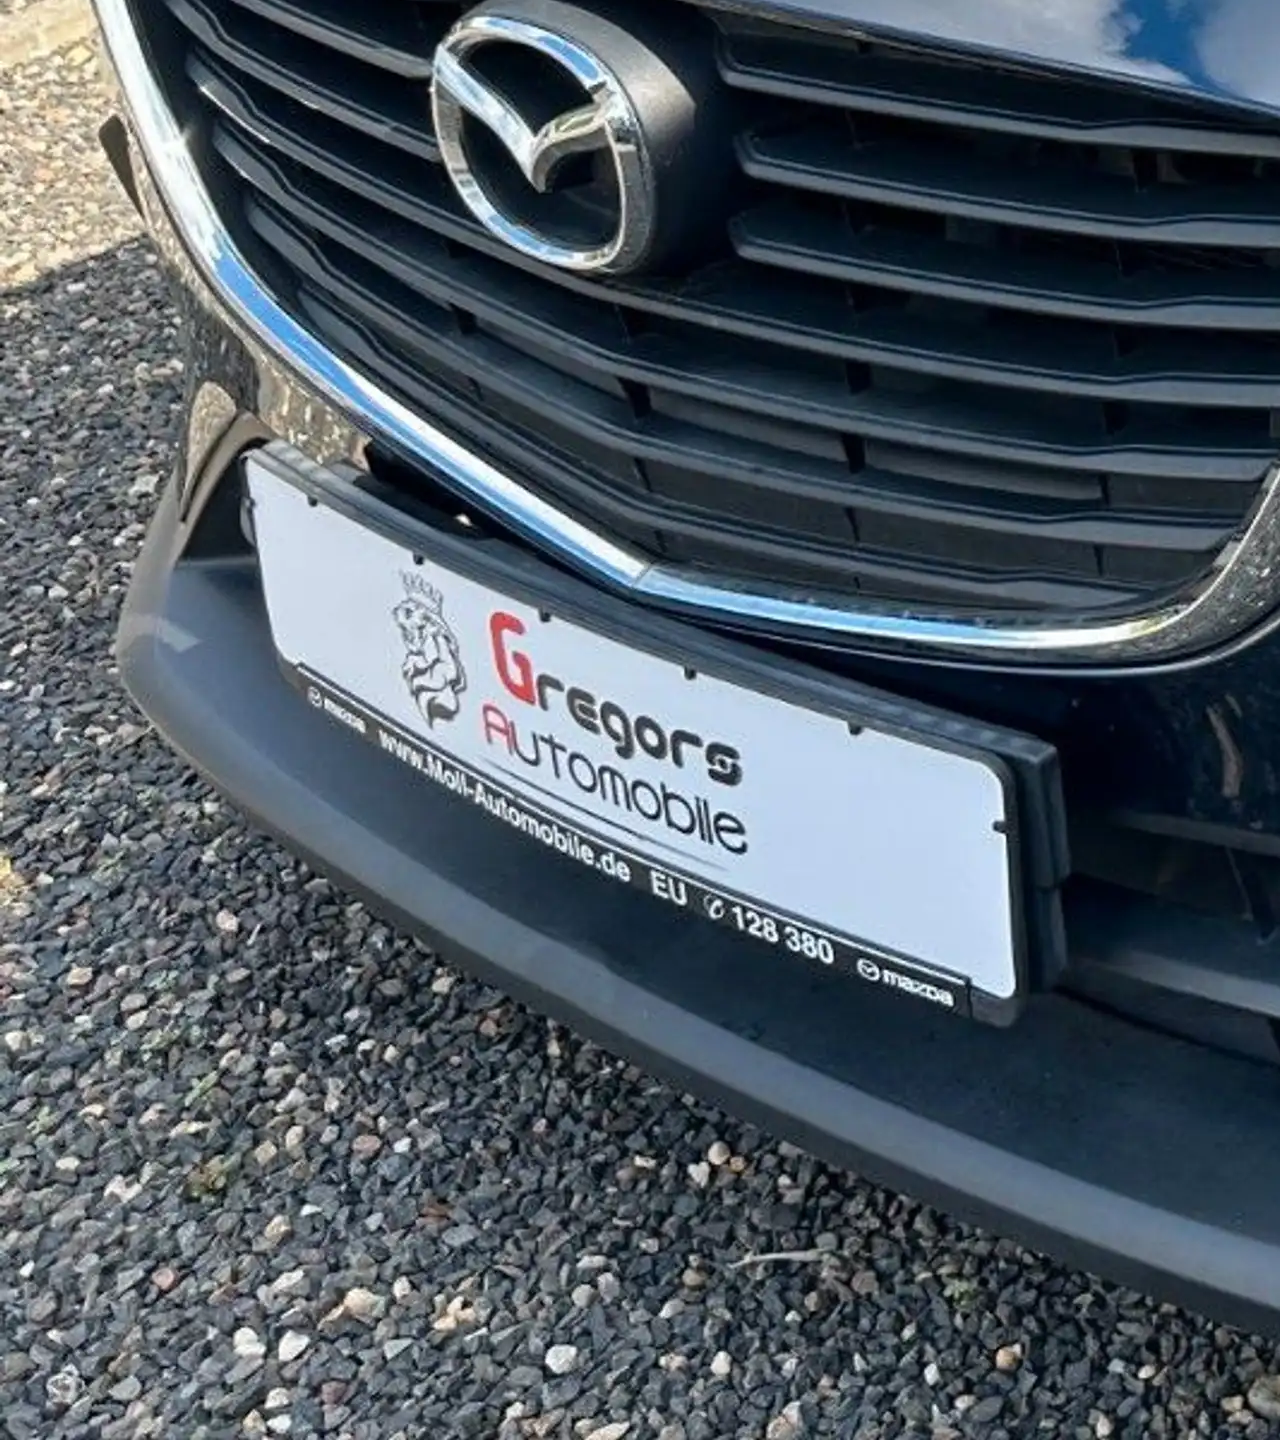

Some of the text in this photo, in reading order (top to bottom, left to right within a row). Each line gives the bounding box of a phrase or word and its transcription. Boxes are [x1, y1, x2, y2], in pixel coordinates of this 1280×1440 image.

[482, 703, 748, 855] Automobile
[490, 612, 743, 786] Gregors
[378, 729, 632, 883] www.Moll-Automobile.de
[650, 870, 687, 906] EU
[732, 906, 779, 944] 128
[784, 926, 834, 965] 380
[882, 969, 954, 1007] mazda
